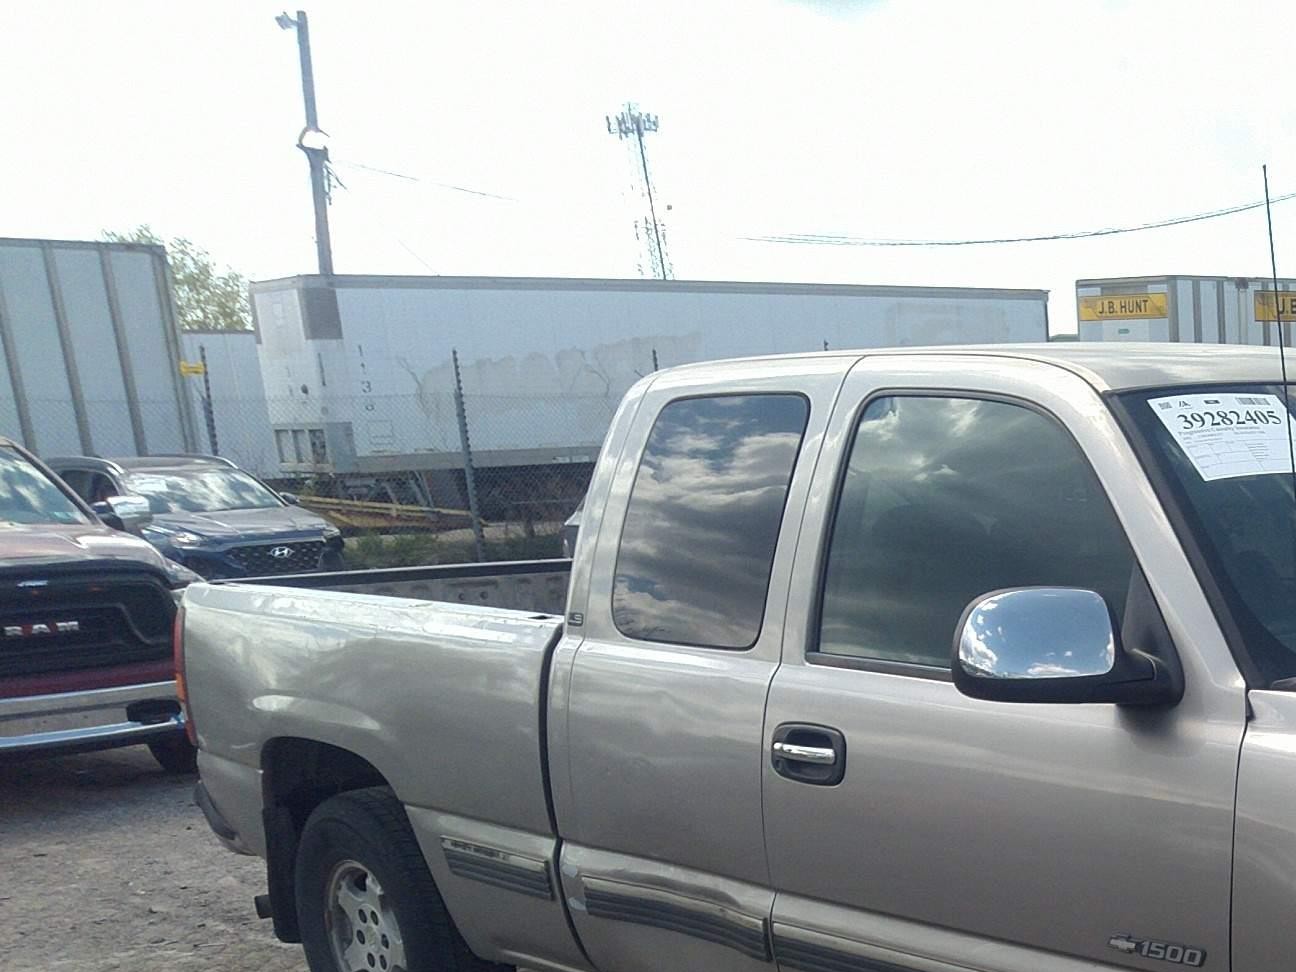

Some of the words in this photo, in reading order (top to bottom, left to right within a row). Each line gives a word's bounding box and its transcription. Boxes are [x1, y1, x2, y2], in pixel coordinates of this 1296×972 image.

[1098, 300, 1118, 314] J.B.
[1119, 299, 1149, 314] HUNT
[1176, 409, 1282, 430] 39282405
[3, 620, 80, 637] RAM
[1140, 940, 1203, 967] 1500
